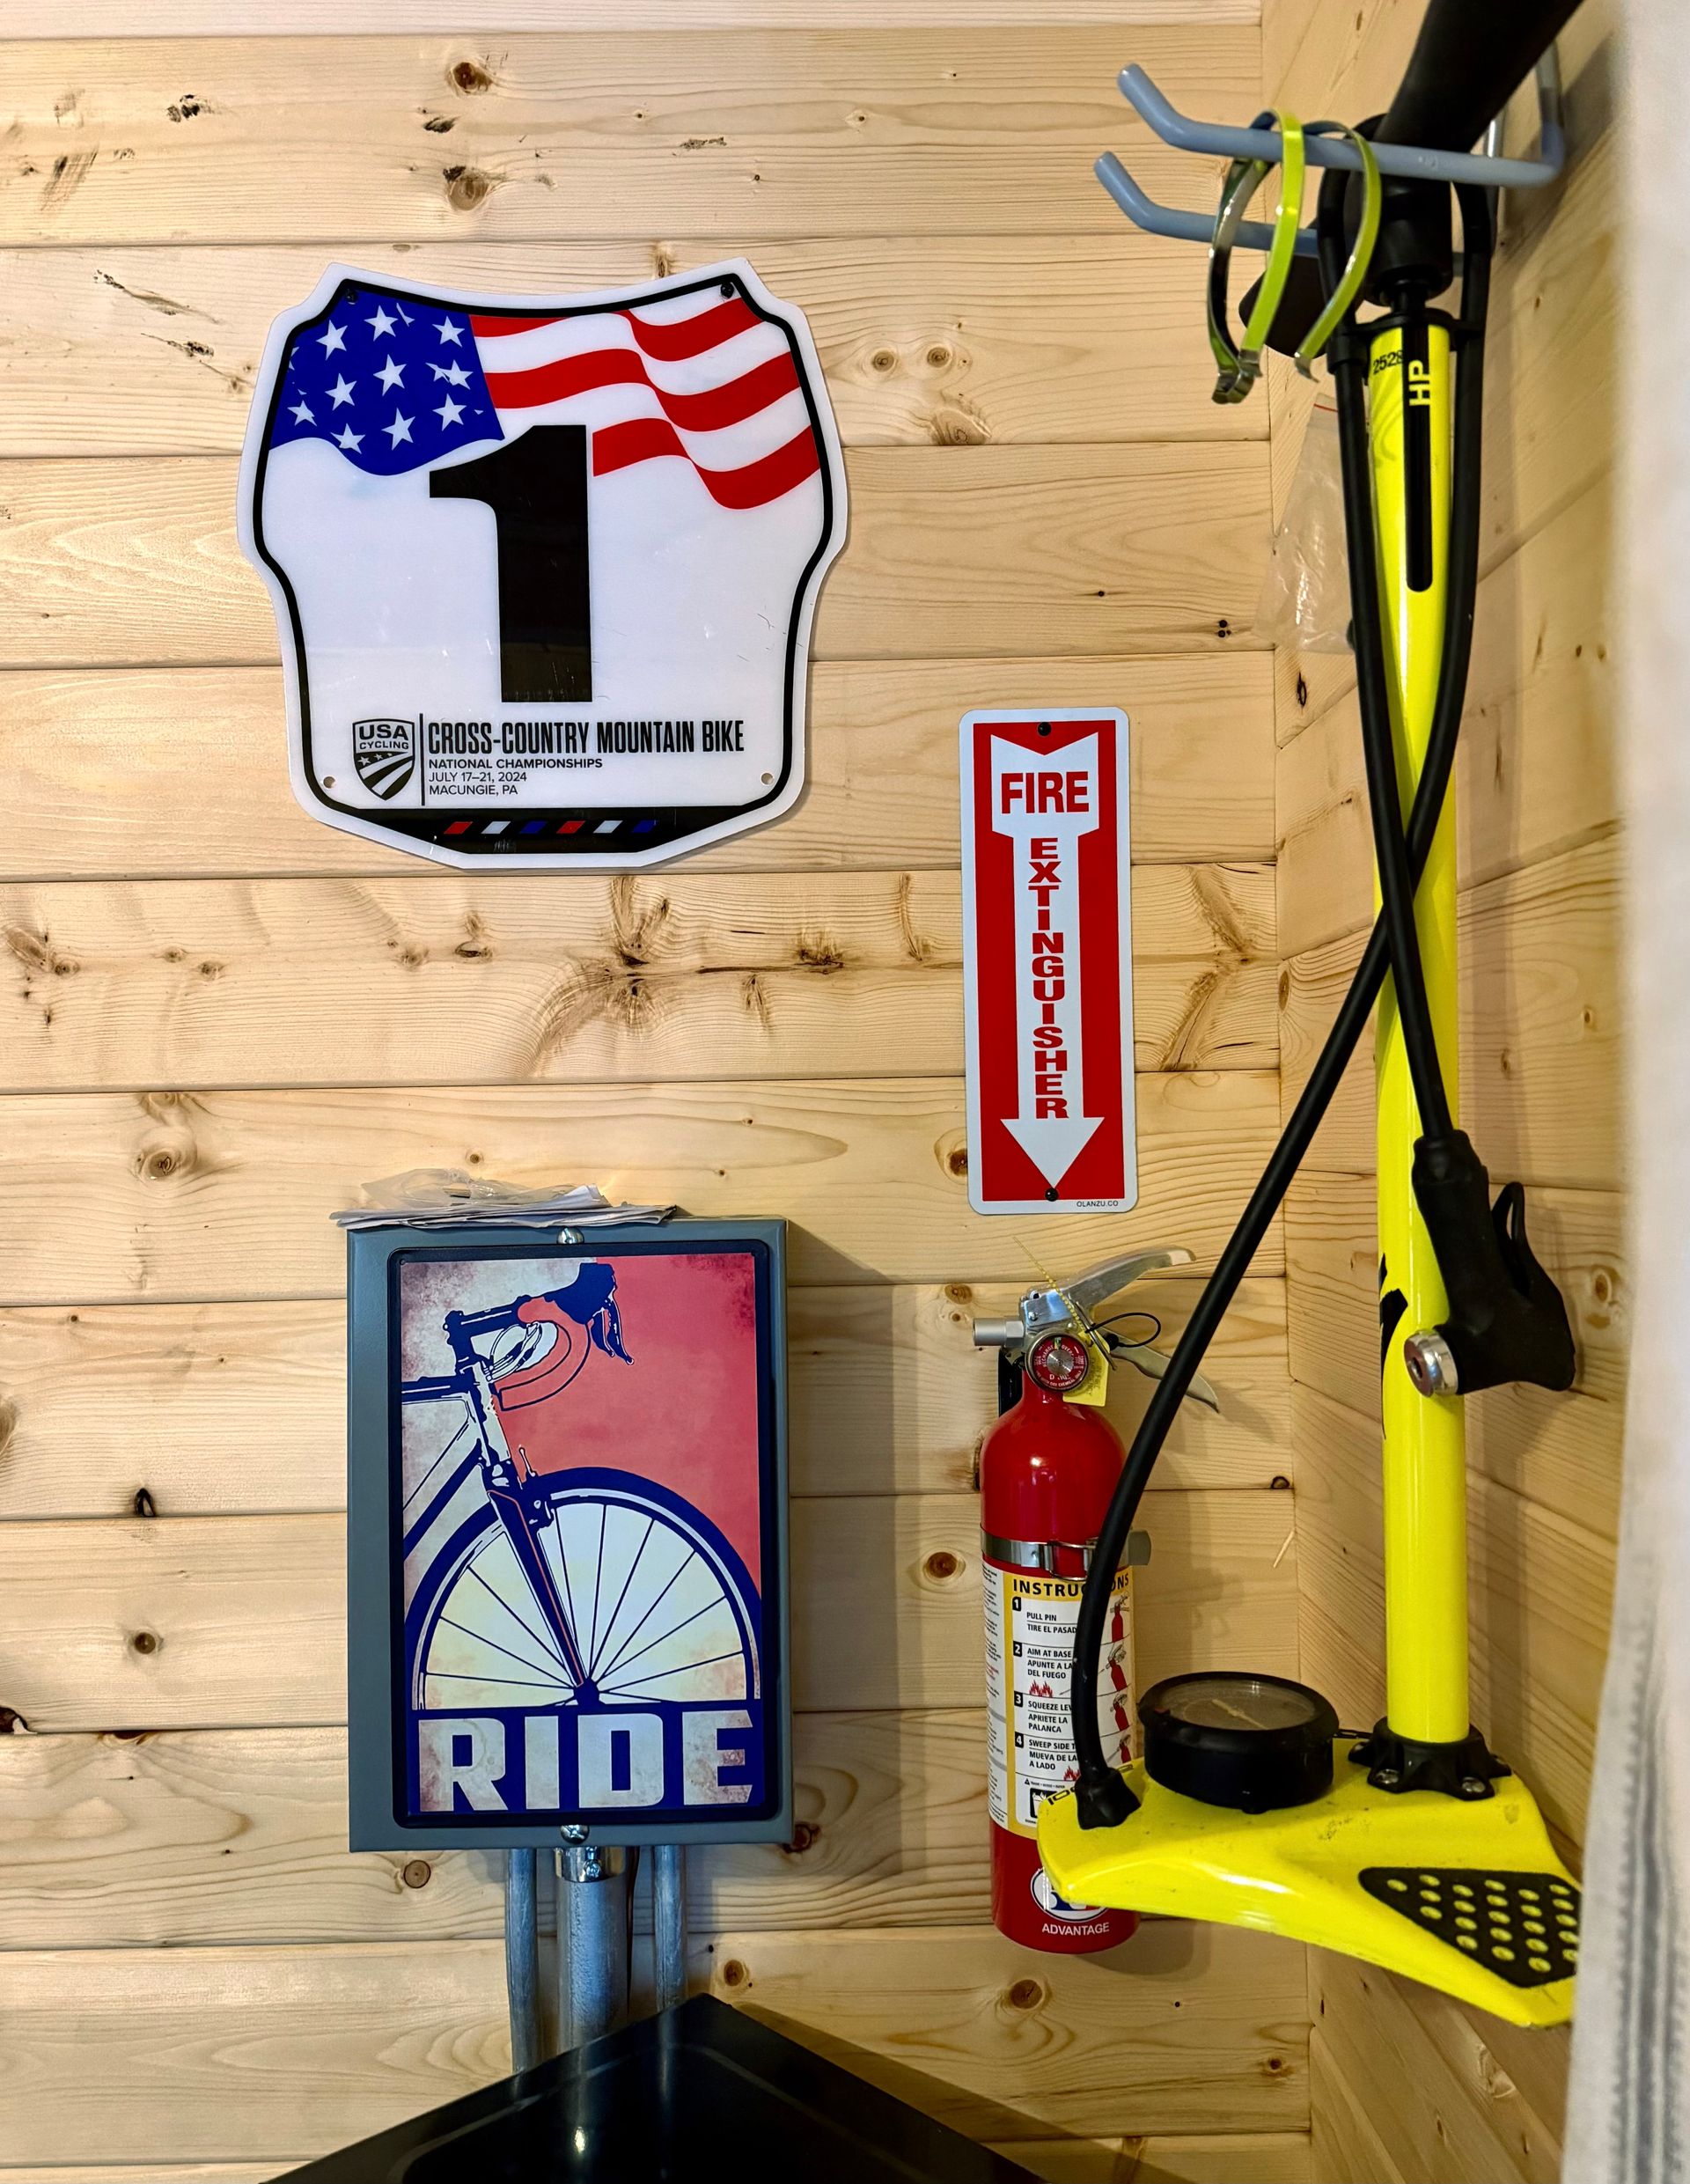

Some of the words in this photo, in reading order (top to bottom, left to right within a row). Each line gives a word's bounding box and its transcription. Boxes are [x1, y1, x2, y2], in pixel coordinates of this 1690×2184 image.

[1408, 359, 1430, 407] HP
[430, 424, 593, 702] 1
[359, 724, 409, 740] USA
[428, 722, 590, 754] CROSS-COUNTRY
[597, 721, 694, 754] MOUNTAIN
[702, 720, 745, 753] BIKE
[359, 740, 409, 750] CYCLING
[429, 759, 493, 769] NATIONAL
[496, 758, 603, 768] CHAMPIONSHIPS
[429, 772, 458, 782] JULY
[498, 772, 527, 782] 2024
[430, 784, 499, 796] MACUNGIE,
[503, 784, 518, 795] PA
[1001, 771, 1090, 814] FIRE
[1028, 837, 1070, 1120] EXTINGUISHER
[1026, 1612, 1043, 1621] PULL
[1027, 1623, 1041, 1632] TIRE
[1014, 1644, 1021, 1655] 2
[1027, 1647, 1041, 1656] AIM
[1027, 1659, 1055, 1669] APUNTE
[1015, 1694, 1022, 1705] 3
[1028, 1700, 1059, 1710] SQUEEZE
[1028, 1713, 1057, 1724] APRIETE
[1028, 1723, 1062, 1733] PALANCA
[1016, 1735, 1023, 1746] 4
[1029, 1739, 1052, 1749] SWEEP
[1029, 1750, 1055, 1761] MUEVA
[418, 1710, 753, 1813] RIDE
[1036, 1761, 1056, 1770] LADO
[1041, 1922, 1110, 1936] ADVANTAGE
